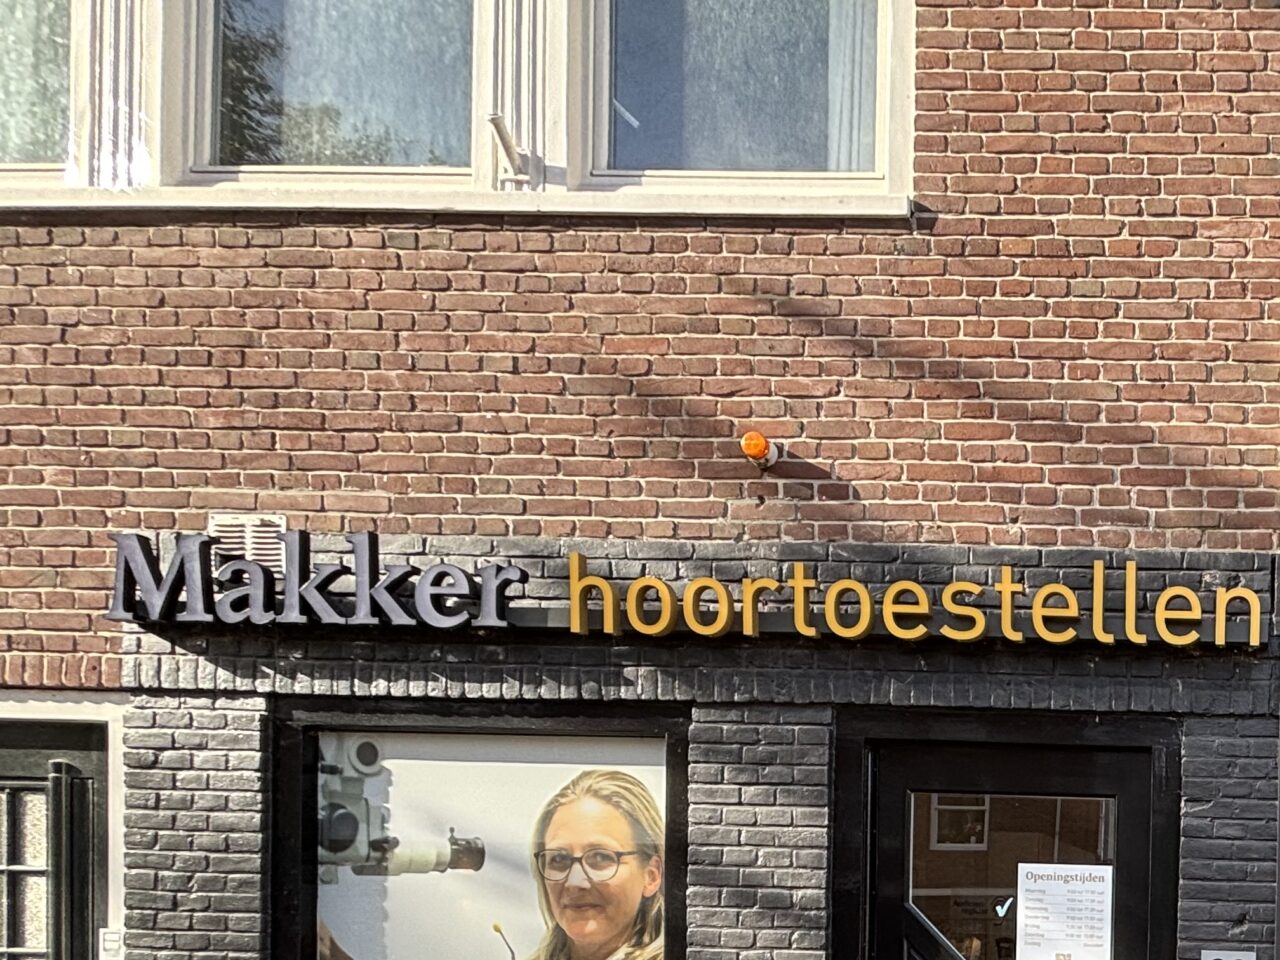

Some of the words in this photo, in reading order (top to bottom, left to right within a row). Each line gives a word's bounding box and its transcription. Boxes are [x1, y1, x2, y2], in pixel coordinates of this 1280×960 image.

[107, 529, 529, 630] Makker
[568, 551, 1261, 648] hoortoestellen
[1025, 871, 1105, 884] Openingstijden
